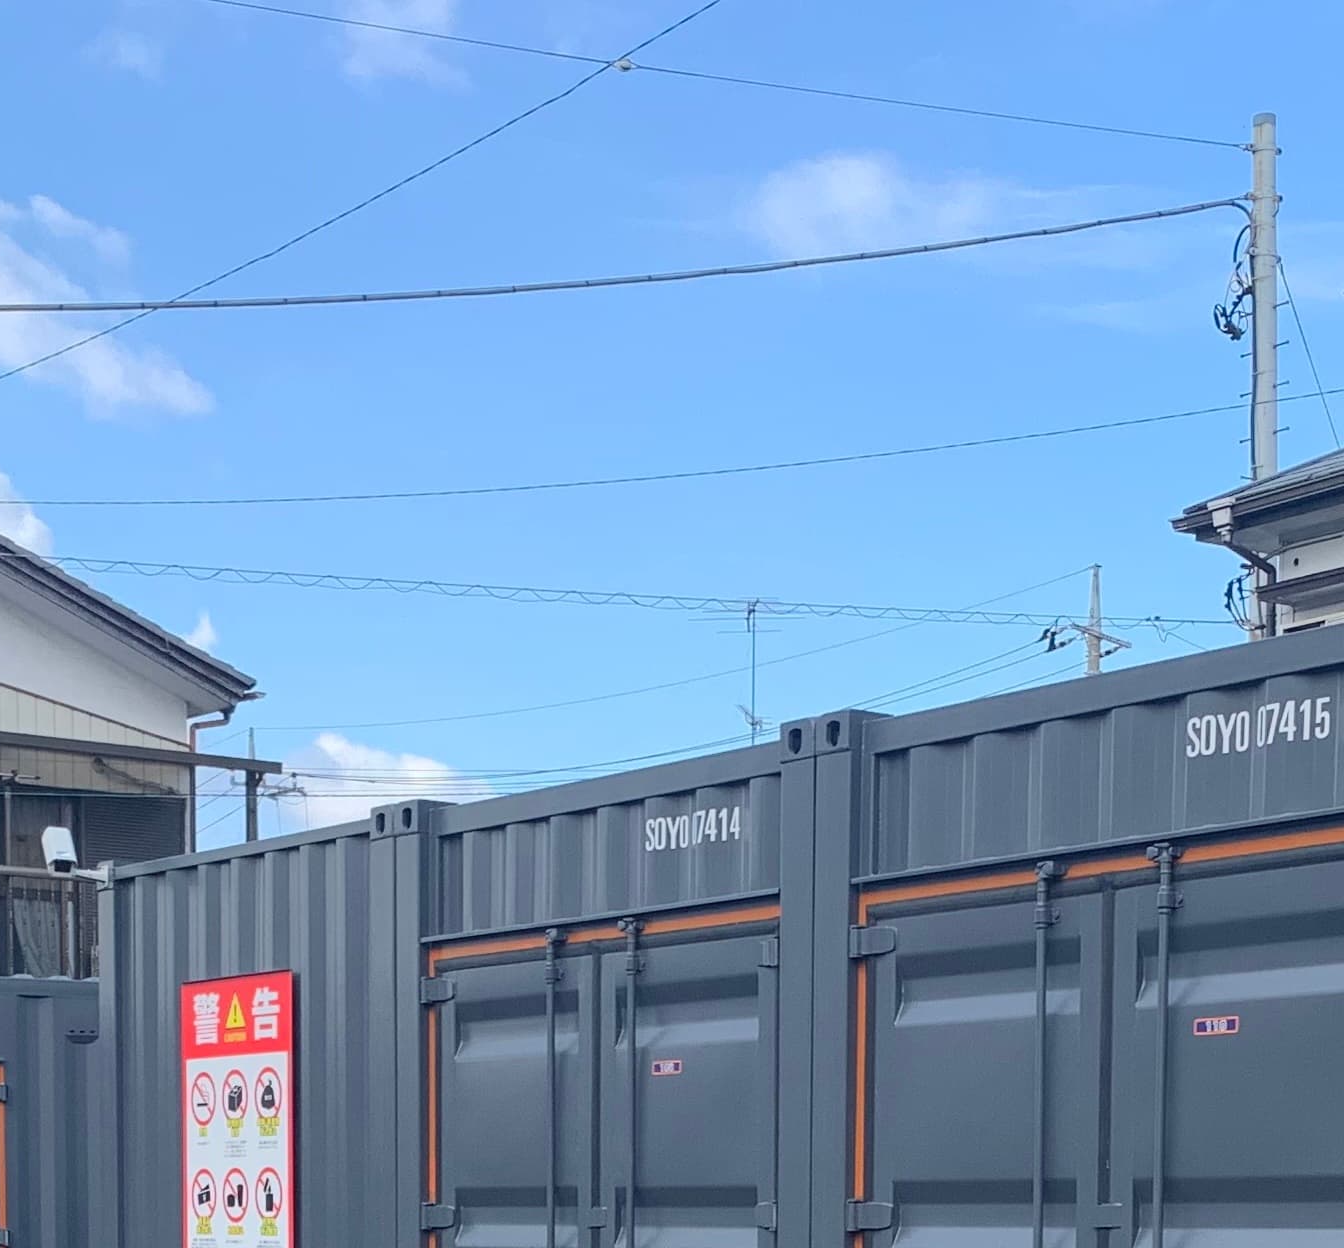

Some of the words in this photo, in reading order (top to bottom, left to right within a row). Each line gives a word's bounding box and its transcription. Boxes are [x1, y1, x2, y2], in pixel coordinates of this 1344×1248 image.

[1185, 709, 1251, 758] SOYO
[1256, 695, 1331, 748] 07415
[645, 816, 689, 852] SOYO
[691, 806, 741, 846] 07414
